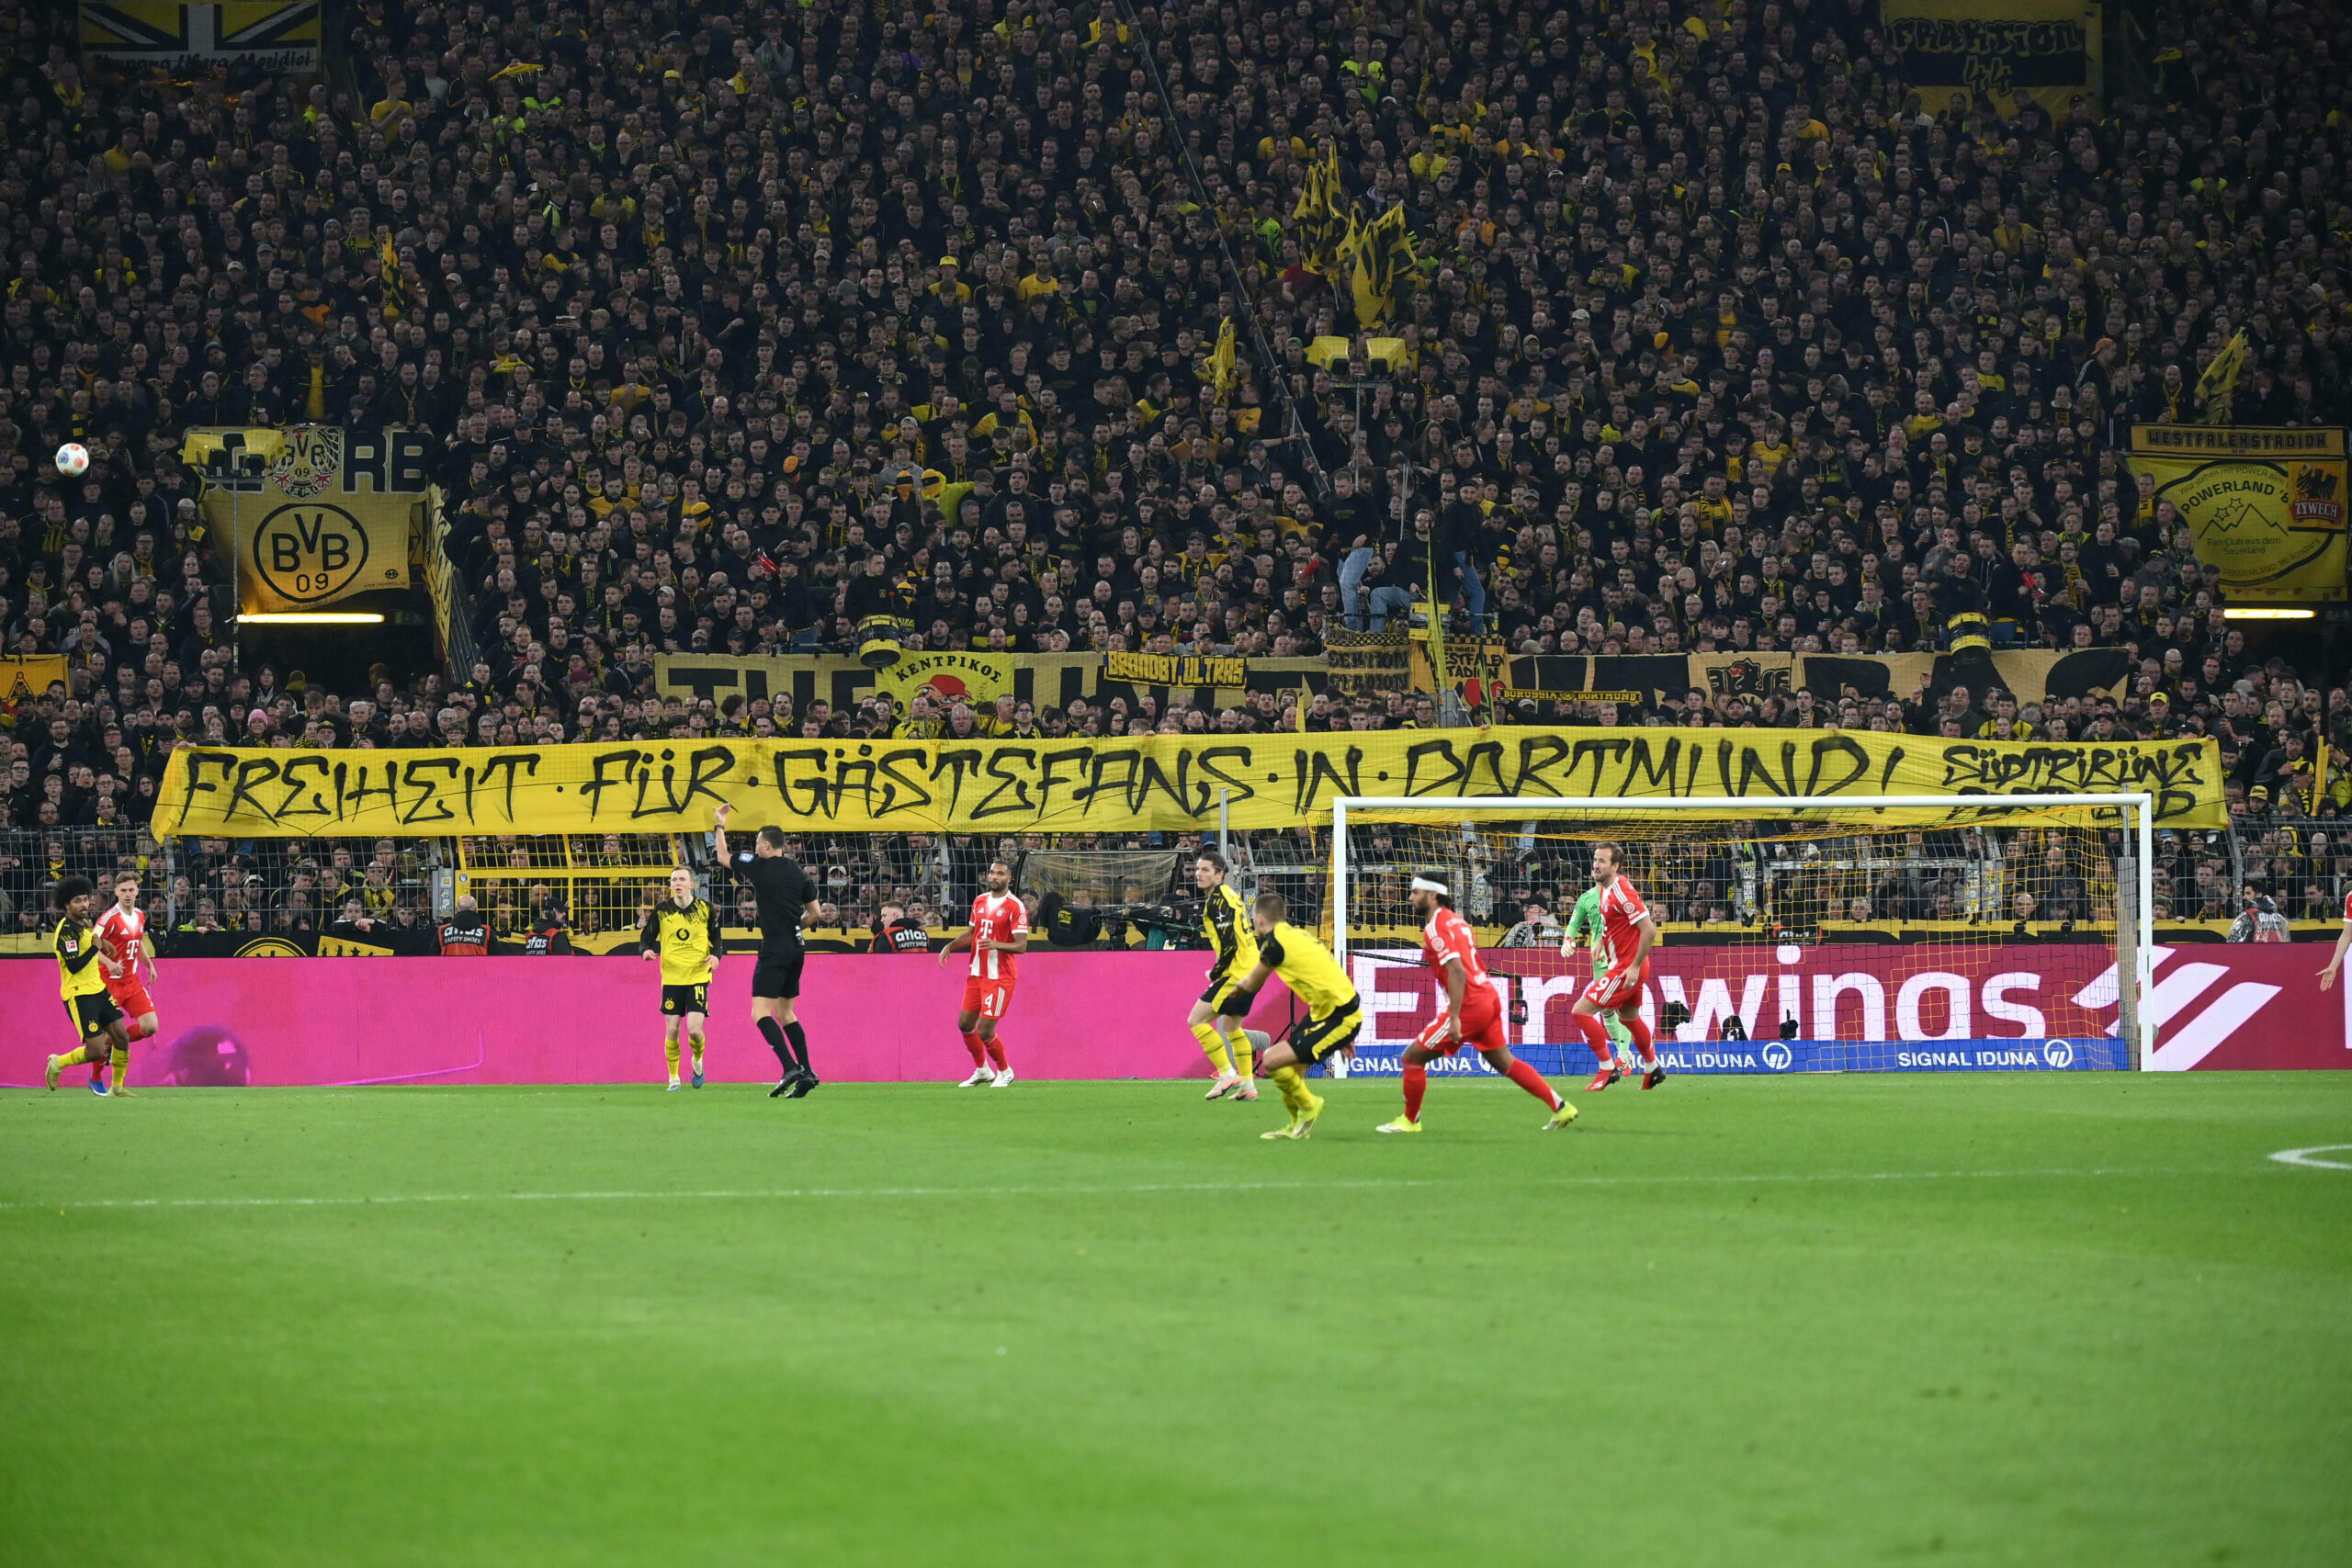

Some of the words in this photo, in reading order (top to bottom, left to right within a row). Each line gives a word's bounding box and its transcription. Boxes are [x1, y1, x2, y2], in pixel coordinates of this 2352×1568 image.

[2146, 428, 2328, 449] WESTFALENSTADION
[2236, 467, 2267, 477] POWER
[2180, 480, 2276, 514] POWERLAND
[271, 513, 350, 572] BVB
[2207, 537, 2223, 546] Fan
[2224, 537, 2245, 546] Club
[2222, 546, 2267, 555] Sauerland
[296, 573, 329, 593] 09
[1445, 651, 1504, 666] ESTFALEN
[1182, 655, 1245, 684] ULTRAS
[1446, 666, 1498, 679] TADIN
[1503, 689, 1557, 699] BORUSSIA
[1577, 692, 1636, 702] DORTMUND
[1941, 742, 2205, 790] SÜDTRIBÜNE
[179, 752, 541, 827] FREIHEIT
[580, 745, 740, 825] FÜR
[775, 744, 1254, 820] GÄSTEFANS
[1294, 745, 1364, 815] IN
[895, 929, 927, 942] atlas
[1595, 976, 1610, 991] 9
[694, 986, 705, 1000] 14
[985, 992, 994, 1009] 4
[1352, 945, 2046, 1046] Erwings
[1423, 1056, 1473, 1072] UNA
[1631, 1054, 1691, 1068] INAL
[1695, 1054, 1758, 1068] IDUNA
[1898, 1051, 1973, 1067] SIGNAL
[1976, 1051, 2039, 1066] IDUNA
